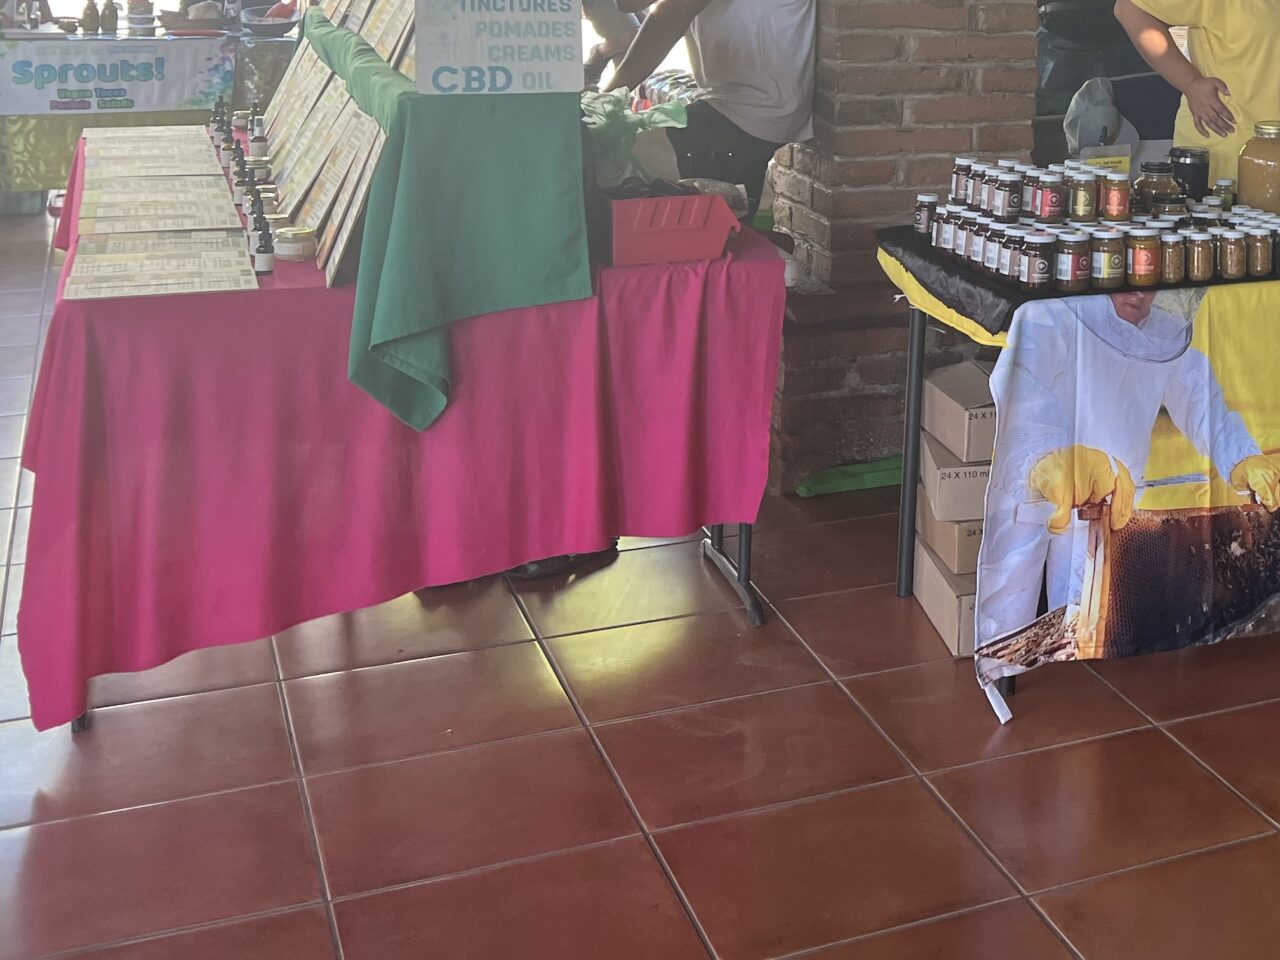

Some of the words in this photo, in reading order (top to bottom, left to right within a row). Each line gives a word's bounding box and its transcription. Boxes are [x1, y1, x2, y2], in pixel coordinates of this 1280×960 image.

[475, 20, 577, 38] POMADES
[487, 44, 576, 62] CREAMS
[11, 57, 165, 89] Sprouts!
[432, 65, 513, 93] CBD
[522, 72, 555, 90] OIL
[969, 412, 978, 421] 24
[941, 472, 951, 480] 24
[963, 471, 977, 479] 110
[966, 529, 976, 537] 24
